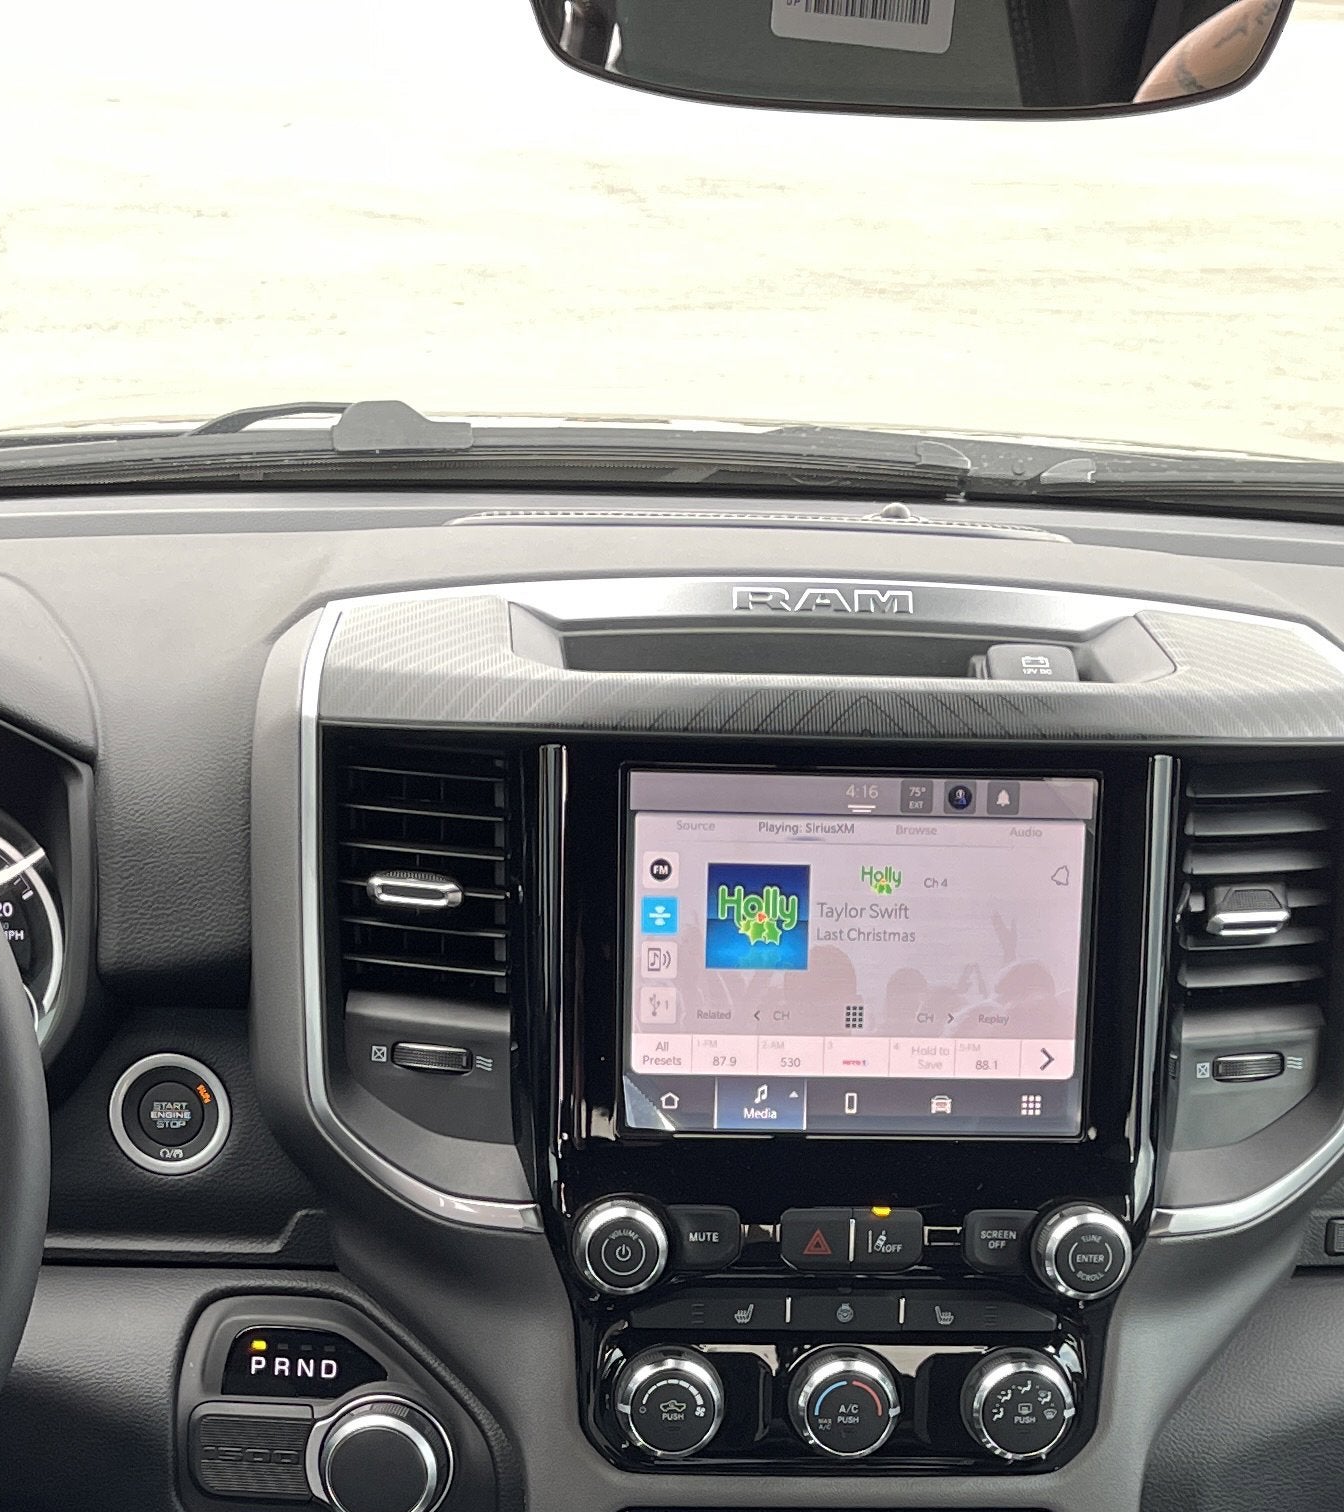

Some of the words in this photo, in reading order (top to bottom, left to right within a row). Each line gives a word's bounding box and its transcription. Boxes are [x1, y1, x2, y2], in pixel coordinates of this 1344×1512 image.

[732, 586, 914, 614] RAM
[846, 785, 879, 799] 4:16
[676, 820, 716, 831] Source
[758, 821, 803, 835] Playing:
[806, 822, 855, 834] SiriusXM
[895, 825, 938, 836] Browse
[1009, 826, 1043, 838] Audio
[653, 865, 669, 875] FM
[860, 865, 902, 888] Holly
[924, 878, 939, 888] Ch
[940, 878, 948, 888] 4
[718, 885, 798, 931] Holly
[817, 902, 866, 920] Taylor
[869, 903, 910, 920] Swift
[817, 928, 844, 941] Last
[847, 928, 916, 942] Christmas
[696, 1009, 731, 1020] Related
[773, 1010, 790, 1021] CH
[917, 1013, 934, 1023] CH
[978, 1014, 1009, 1026] Replay
[655, 1041, 669, 1052] All
[911, 1046, 937, 1056] Hold
[939, 1047, 950, 1056] to
[642, 1055, 682, 1066] Presets
[712, 1056, 737, 1067] 87.9
[780, 1057, 801, 1068] 530
[918, 1059, 943, 1070] Save
[153, 1102, 188, 1110] START
[150, 1111, 191, 1119] ENGINE
[744, 1107, 777, 1119] Media
[610, 1229, 640, 1240] VOLUME
[689, 1231, 719, 1243] MUTE
[980, 1230, 1017, 1240] SCREEN
[885, 1244, 903, 1253] OFF
[988, 1240, 1006, 1249] OFF
[1076, 1254, 1105, 1263] ENTER
[1076, 1270, 1105, 1282] SCROLL
[839, 1404, 859, 1414] A/C
[661, 1412, 685, 1422] PUSH
[837, 1415, 860, 1424] PUSH
[1014, 1415, 1037, 1424] PUSH
